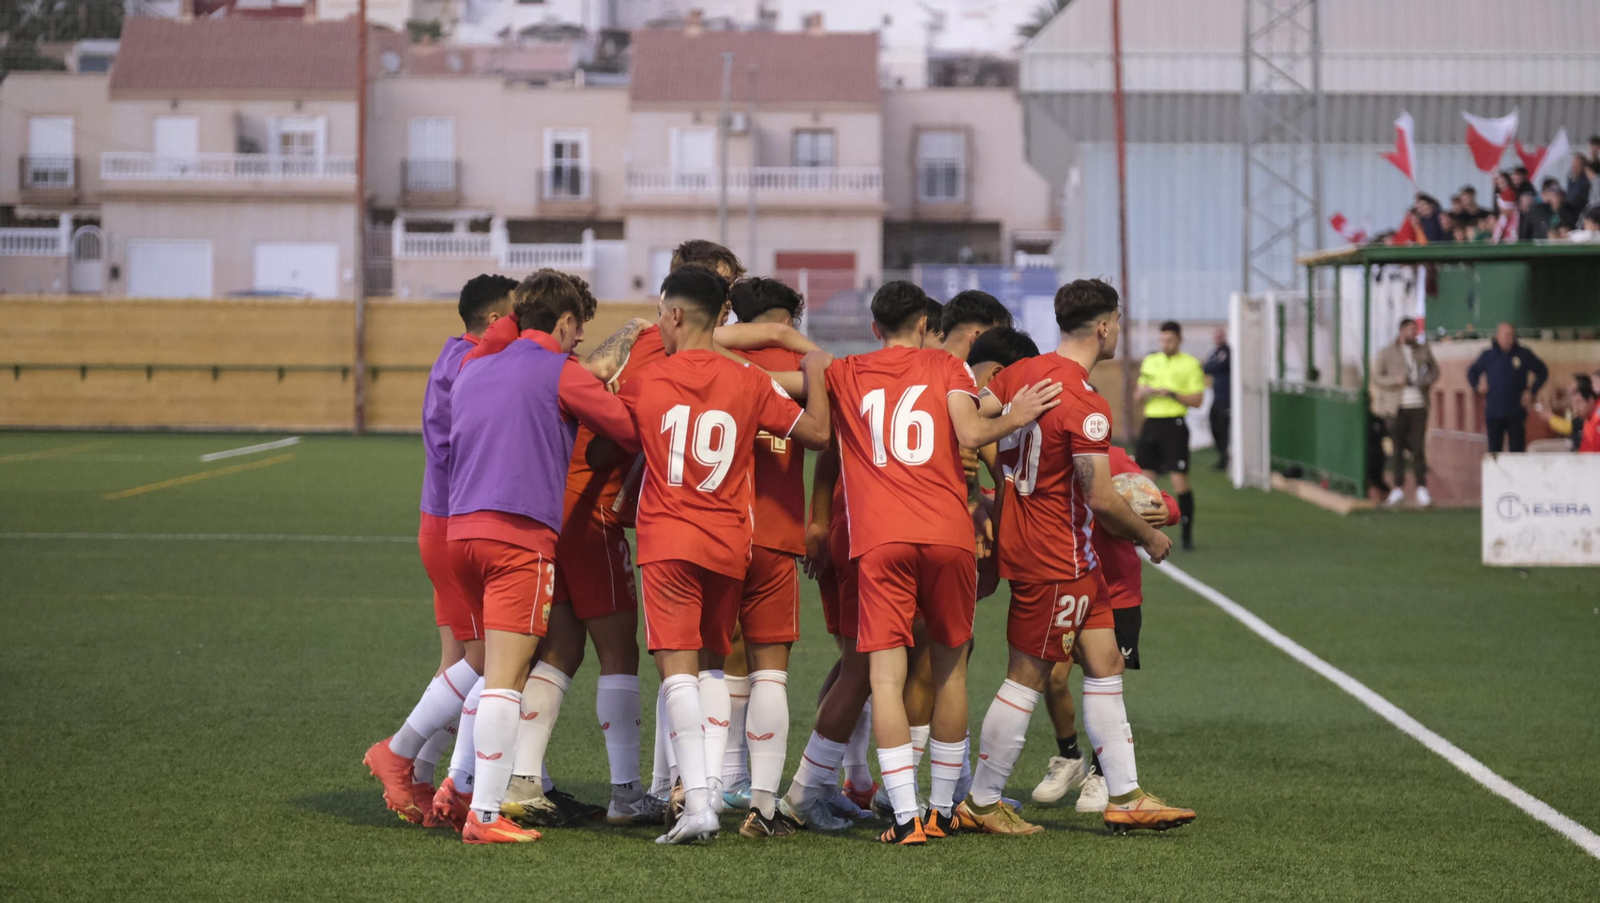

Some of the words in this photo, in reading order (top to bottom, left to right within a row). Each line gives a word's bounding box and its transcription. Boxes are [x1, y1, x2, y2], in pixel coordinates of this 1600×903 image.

[660, 404, 738, 493] 19
[861, 385, 935, 467] 16
[1055, 594, 1089, 627] 20
